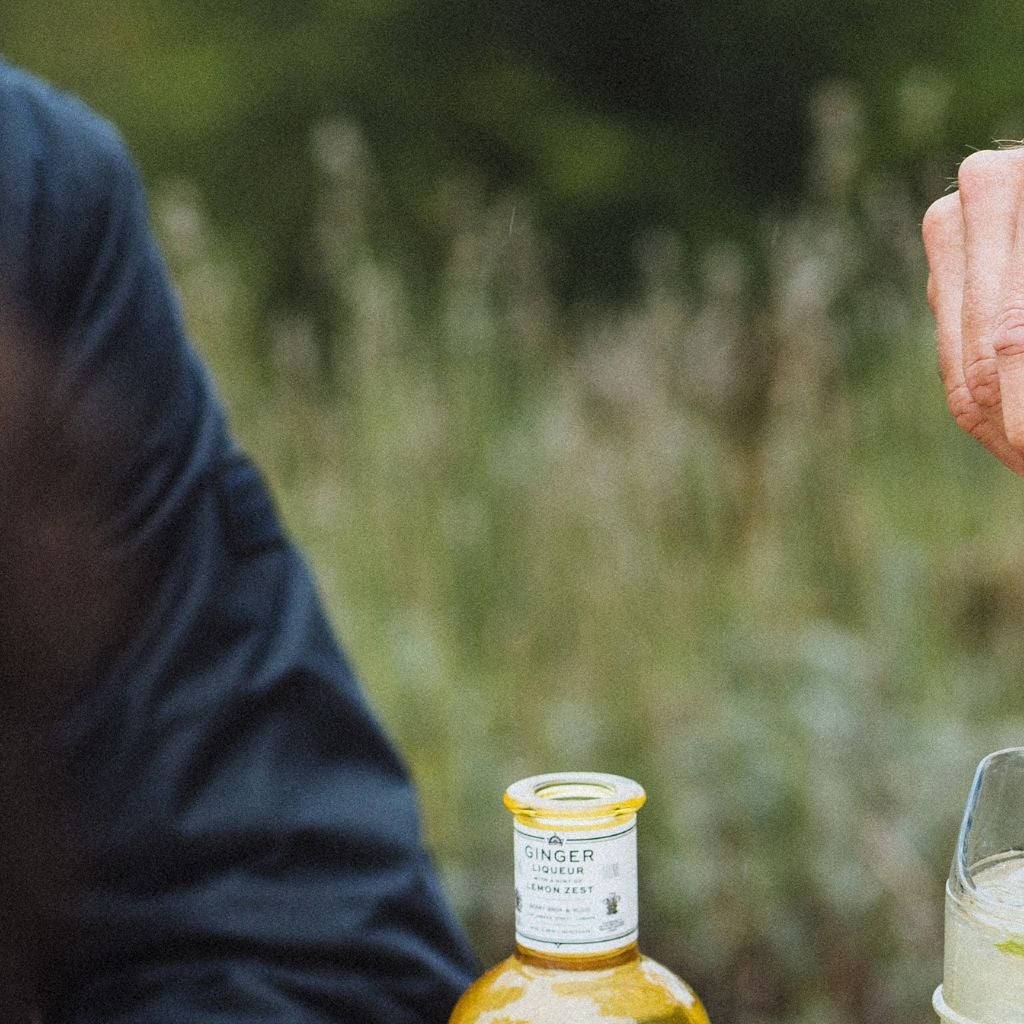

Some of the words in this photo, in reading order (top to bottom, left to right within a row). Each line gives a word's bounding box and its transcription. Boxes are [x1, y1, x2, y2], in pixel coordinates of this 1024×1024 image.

[524, 845, 595, 863] GINGER
[532, 864, 584, 875] LIQUEUR
[526, 882, 560, 894] LEMON
[564, 886, 593, 894] ZEST
